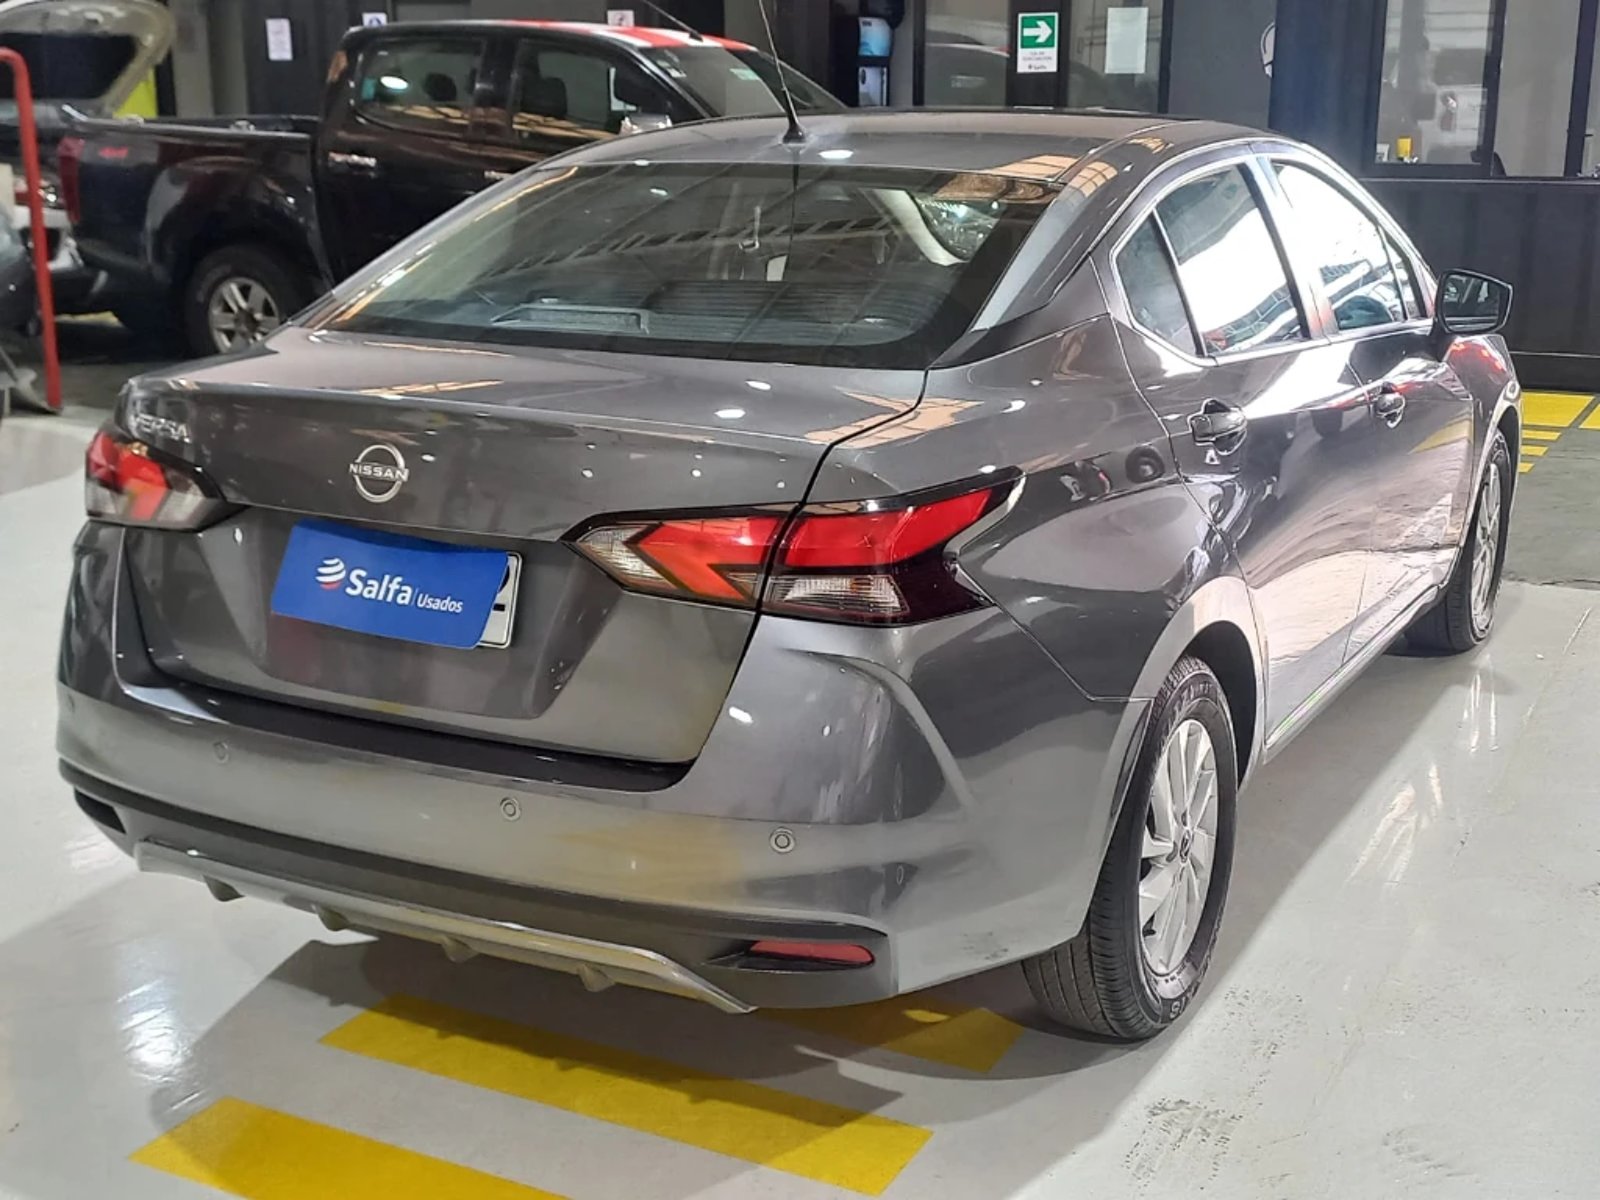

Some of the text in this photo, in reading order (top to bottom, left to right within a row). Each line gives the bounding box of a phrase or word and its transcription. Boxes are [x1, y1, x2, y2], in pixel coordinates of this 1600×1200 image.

[350, 463, 410, 482] NISSAN
[345, 568, 464, 613] Salfa Usados
